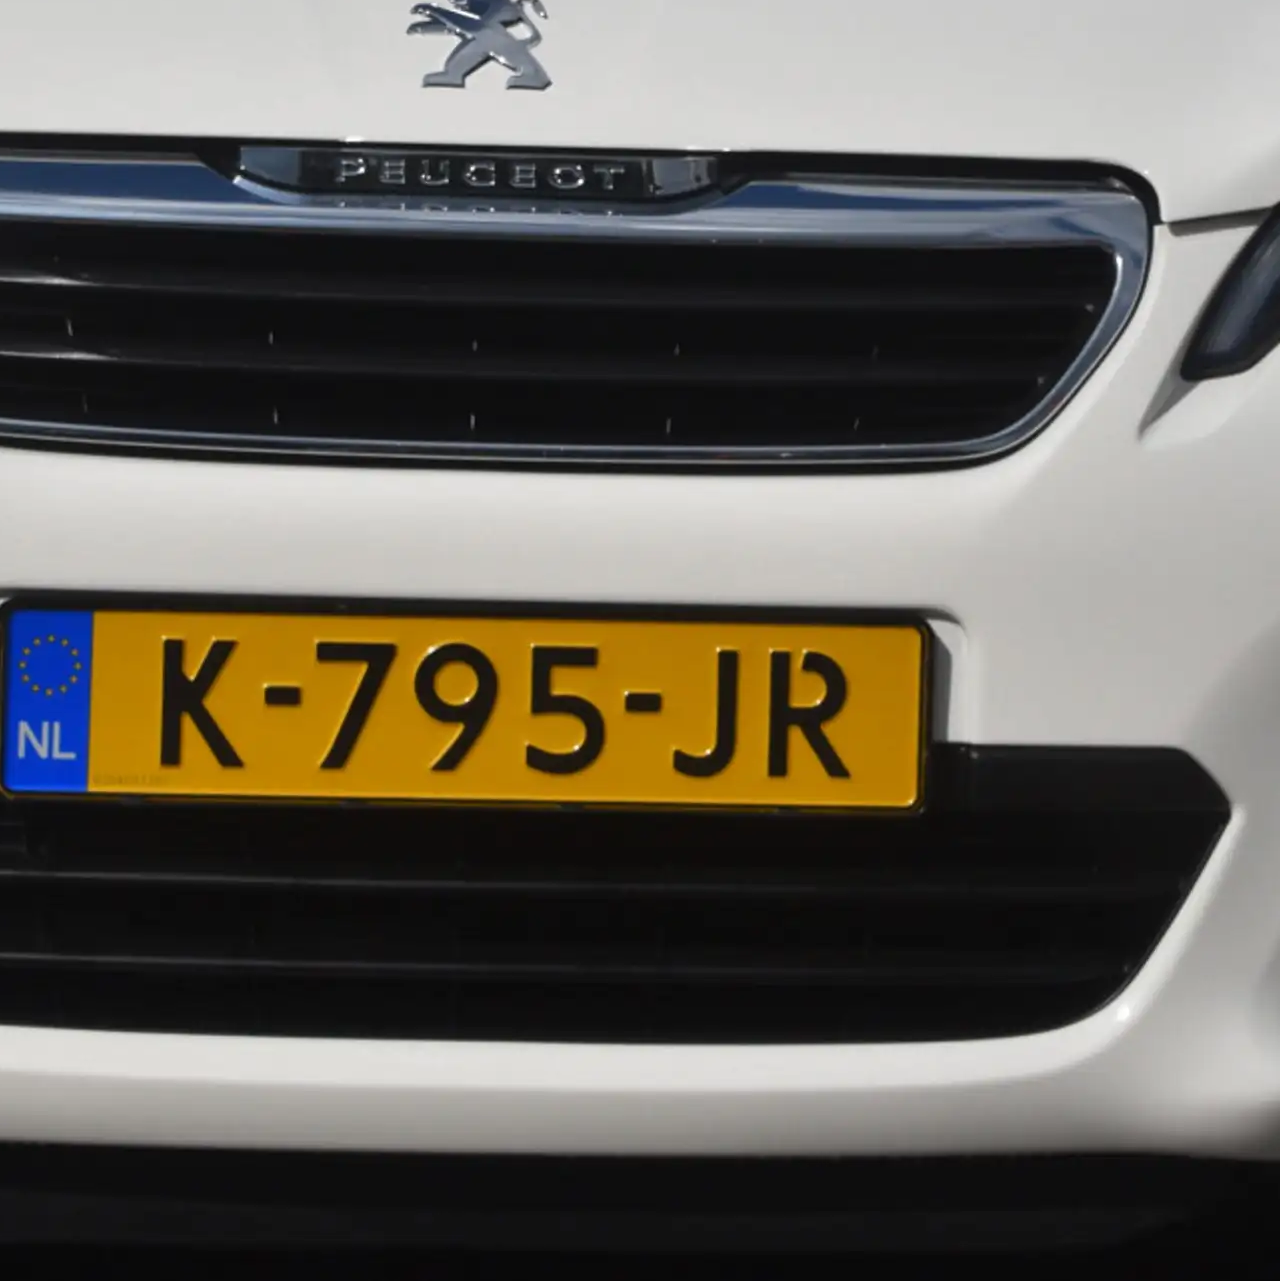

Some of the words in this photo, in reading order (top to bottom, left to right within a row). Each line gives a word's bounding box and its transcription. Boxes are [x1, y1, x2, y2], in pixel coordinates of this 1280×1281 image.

[334, 156, 625, 190] PEUGEOT
[159, 637, 851, 778] K-795-JR
[17, 720, 78, 759] NL
